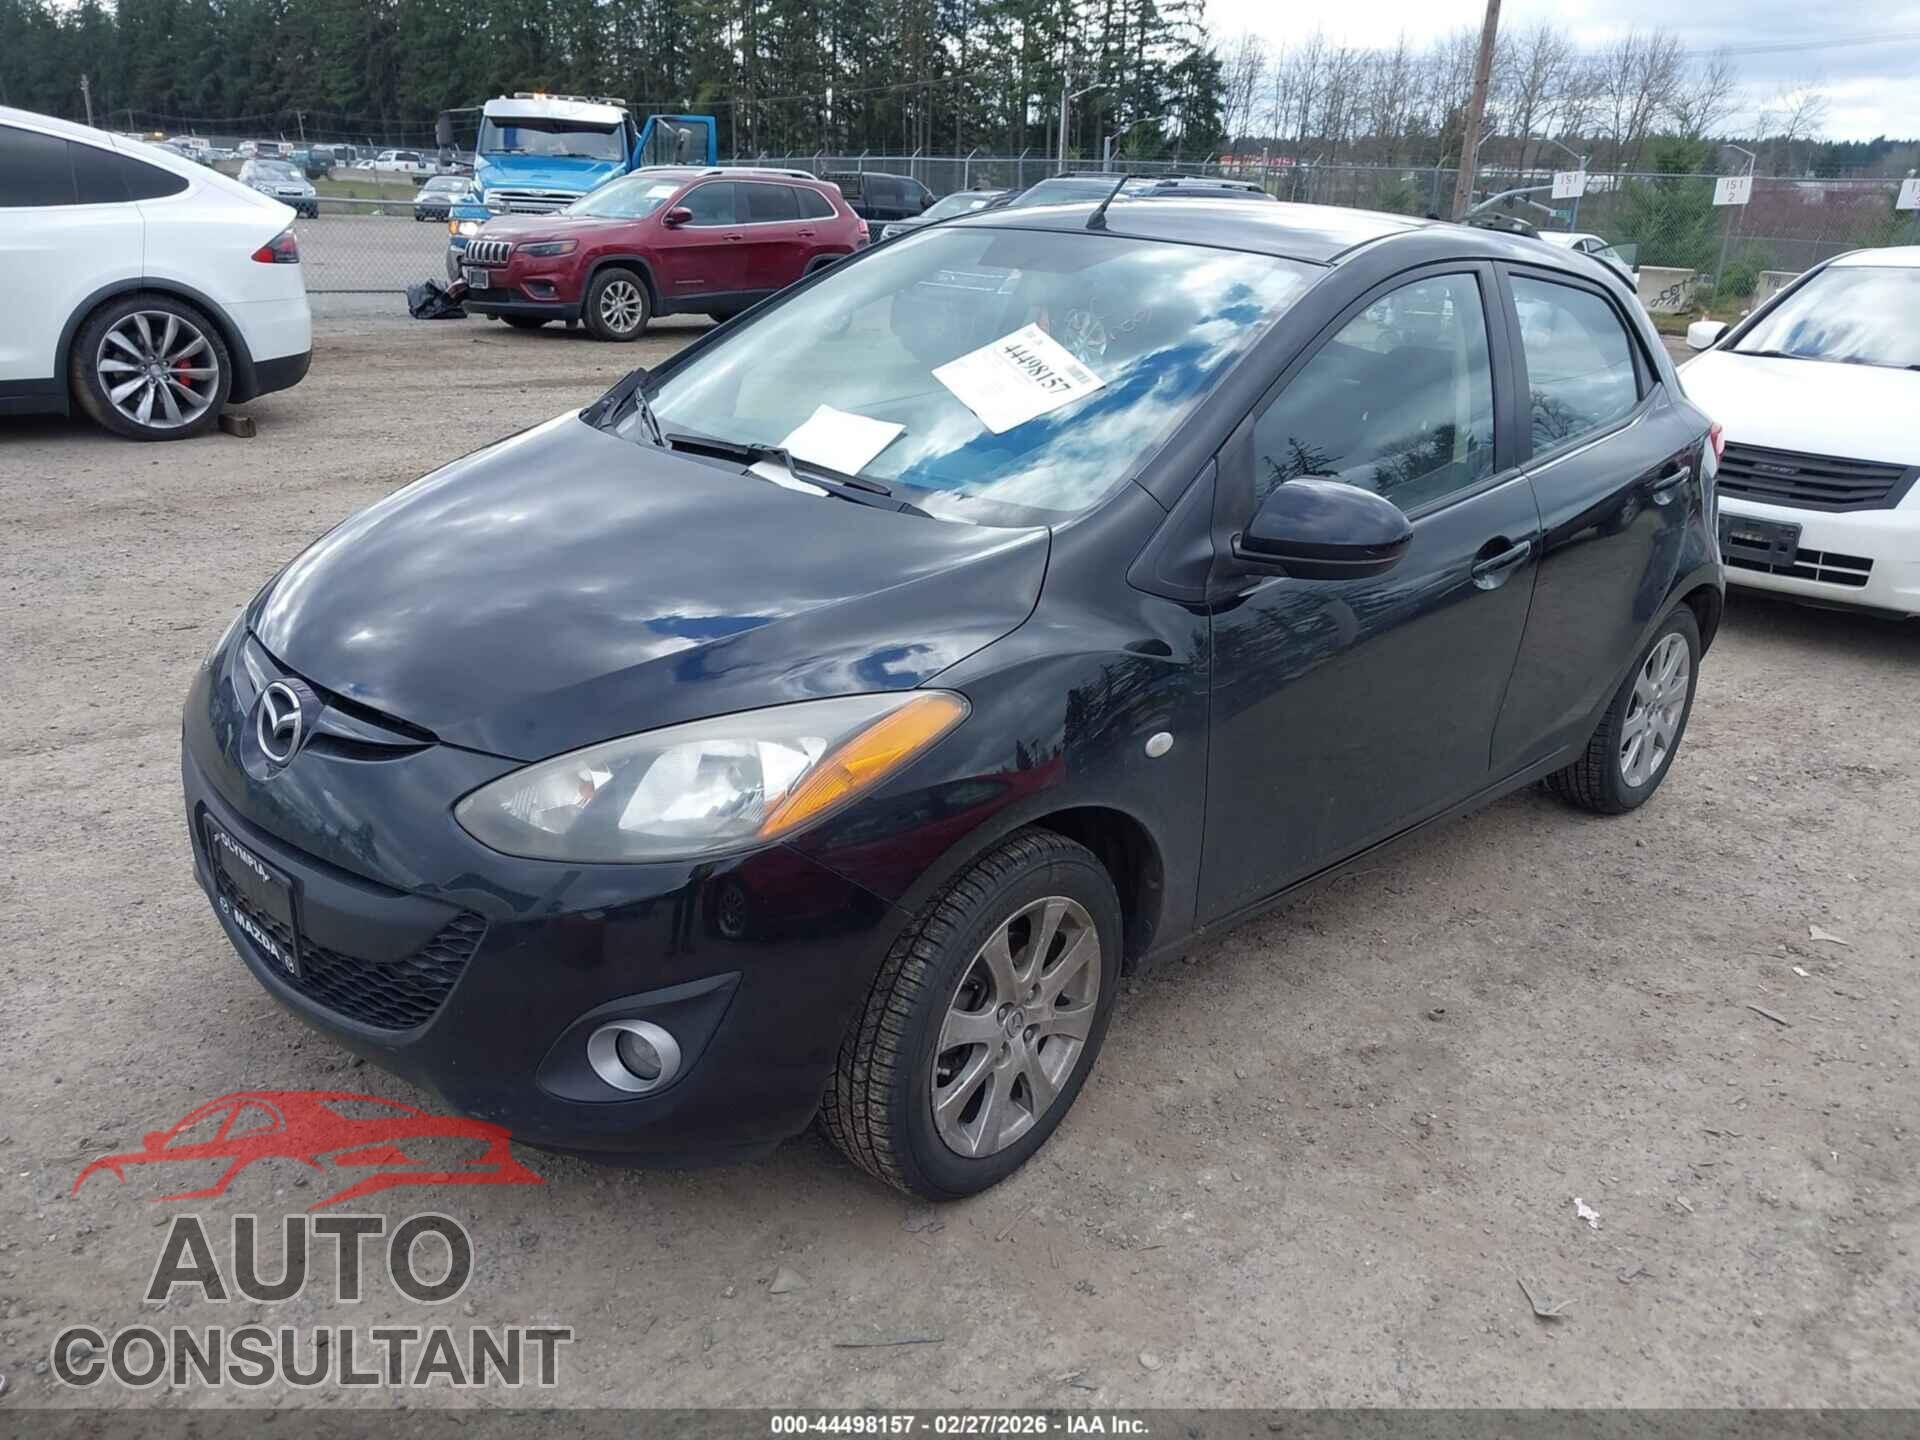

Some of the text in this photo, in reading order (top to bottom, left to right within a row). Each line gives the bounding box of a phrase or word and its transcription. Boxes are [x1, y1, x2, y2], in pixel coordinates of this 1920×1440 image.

[1003, 344, 1072, 394] 44498157
[220, 832, 266, 877] OLYMPIA
[234, 909, 280, 960] MAZDA
